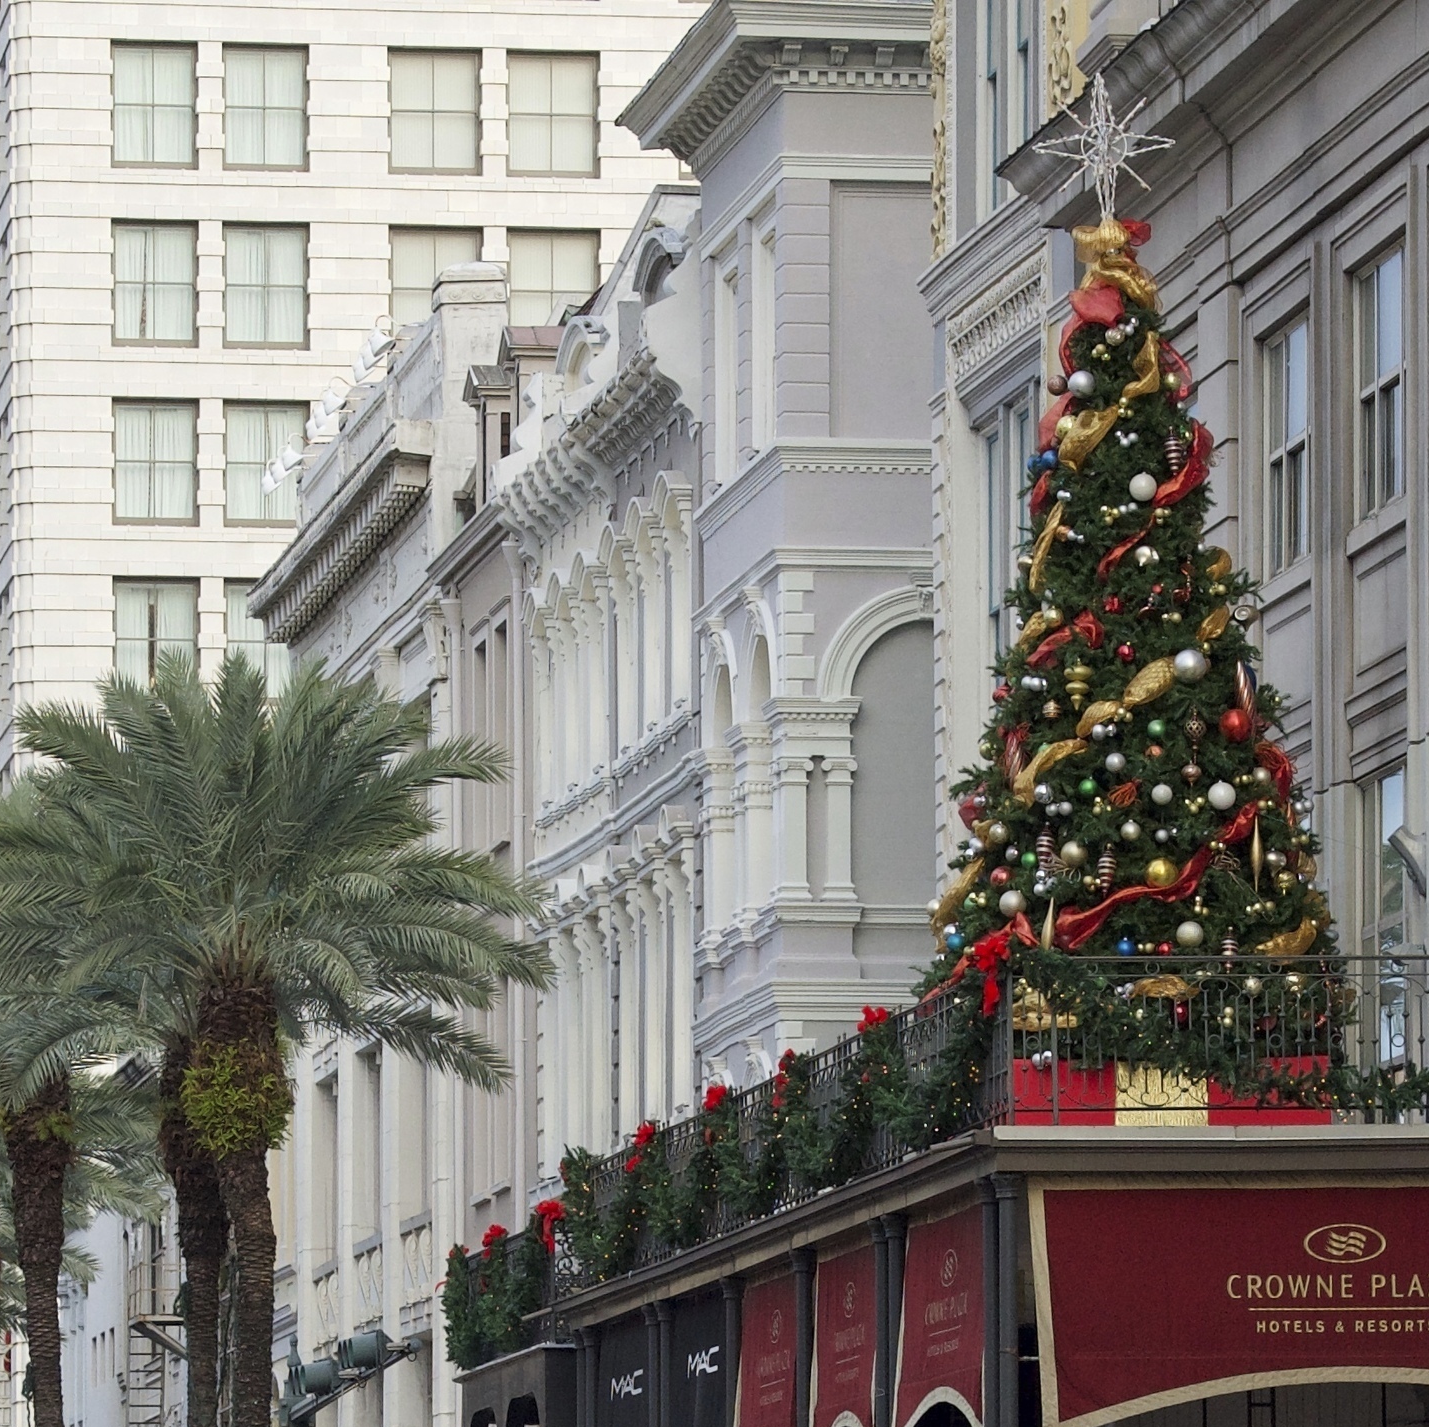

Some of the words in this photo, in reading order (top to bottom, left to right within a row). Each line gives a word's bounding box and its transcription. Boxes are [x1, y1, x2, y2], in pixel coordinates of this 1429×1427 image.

[1226, 1274, 1354, 1299] CROWNE
[1256, 1320, 1325, 1333] HOTELS
[1335, 1321, 1344, 1333] &
[687, 1346, 720, 1379] MAC
[610, 1368, 644, 1401] MAC
